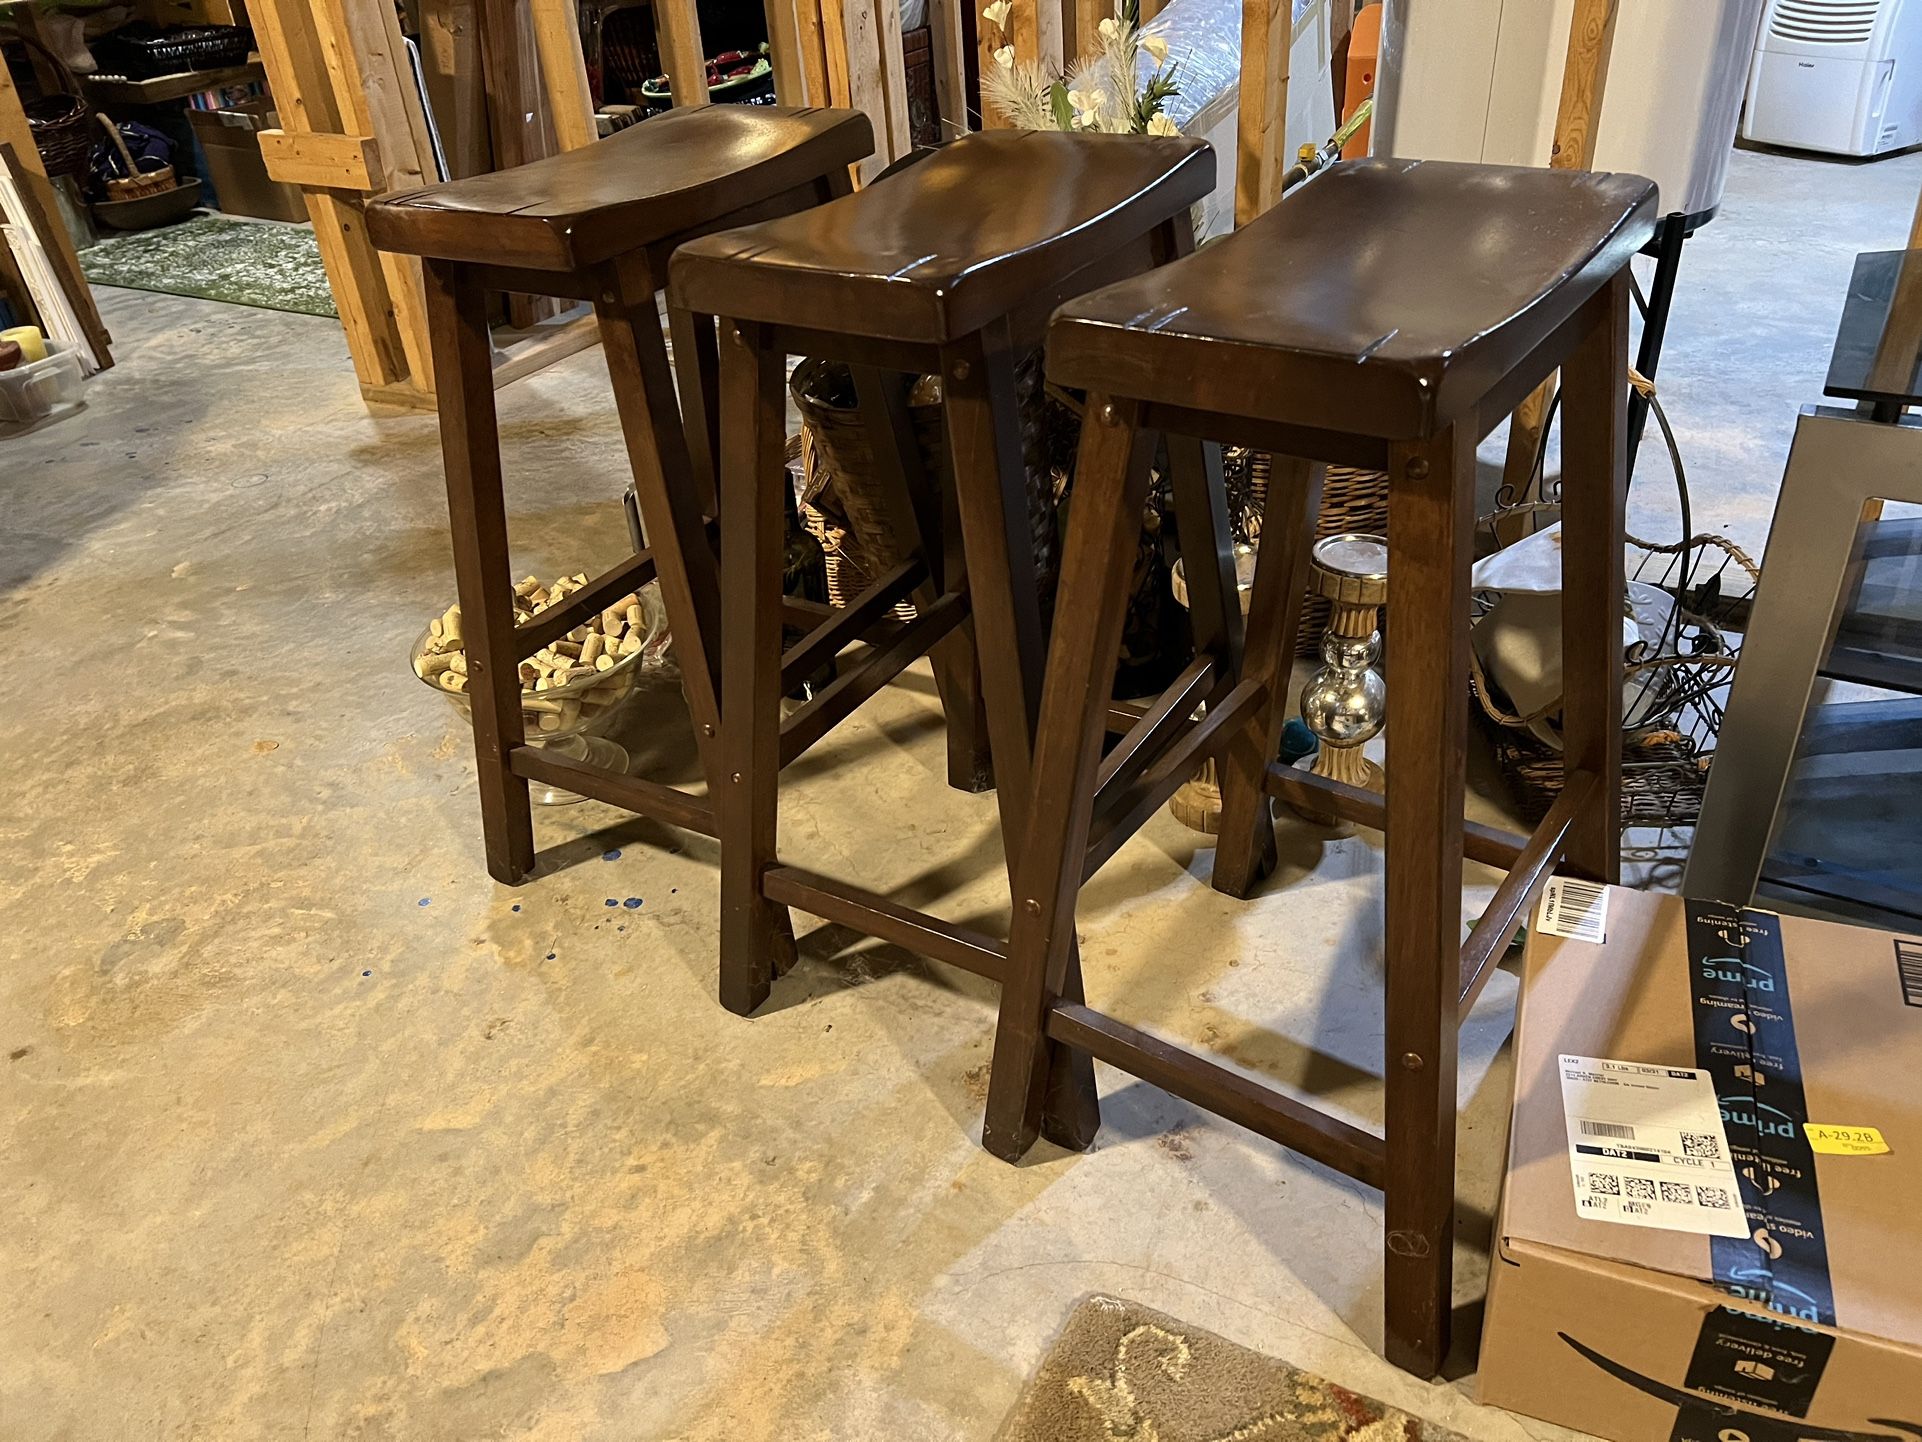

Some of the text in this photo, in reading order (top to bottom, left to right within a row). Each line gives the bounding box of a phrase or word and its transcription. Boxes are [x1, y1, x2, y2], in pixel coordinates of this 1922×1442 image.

[1696, 916, 1743, 933] lstening
[1746, 926, 1769, 936] free
[1702, 968, 1775, 992] prime
[1753, 1010, 1784, 1021] video
[1759, 1059, 1784, 1070] free
[1720, 1110, 1795, 1138] prime
[1602, 1148, 1628, 1158] DAT2
[1673, 1156, 1703, 1167] CYCLE
[1774, 1165, 1802, 1178] free
[1779, 1225, 1814, 1239] video
[1714, 1338, 1773, 1360] delivery
[1775, 1354, 1805, 1368] free
